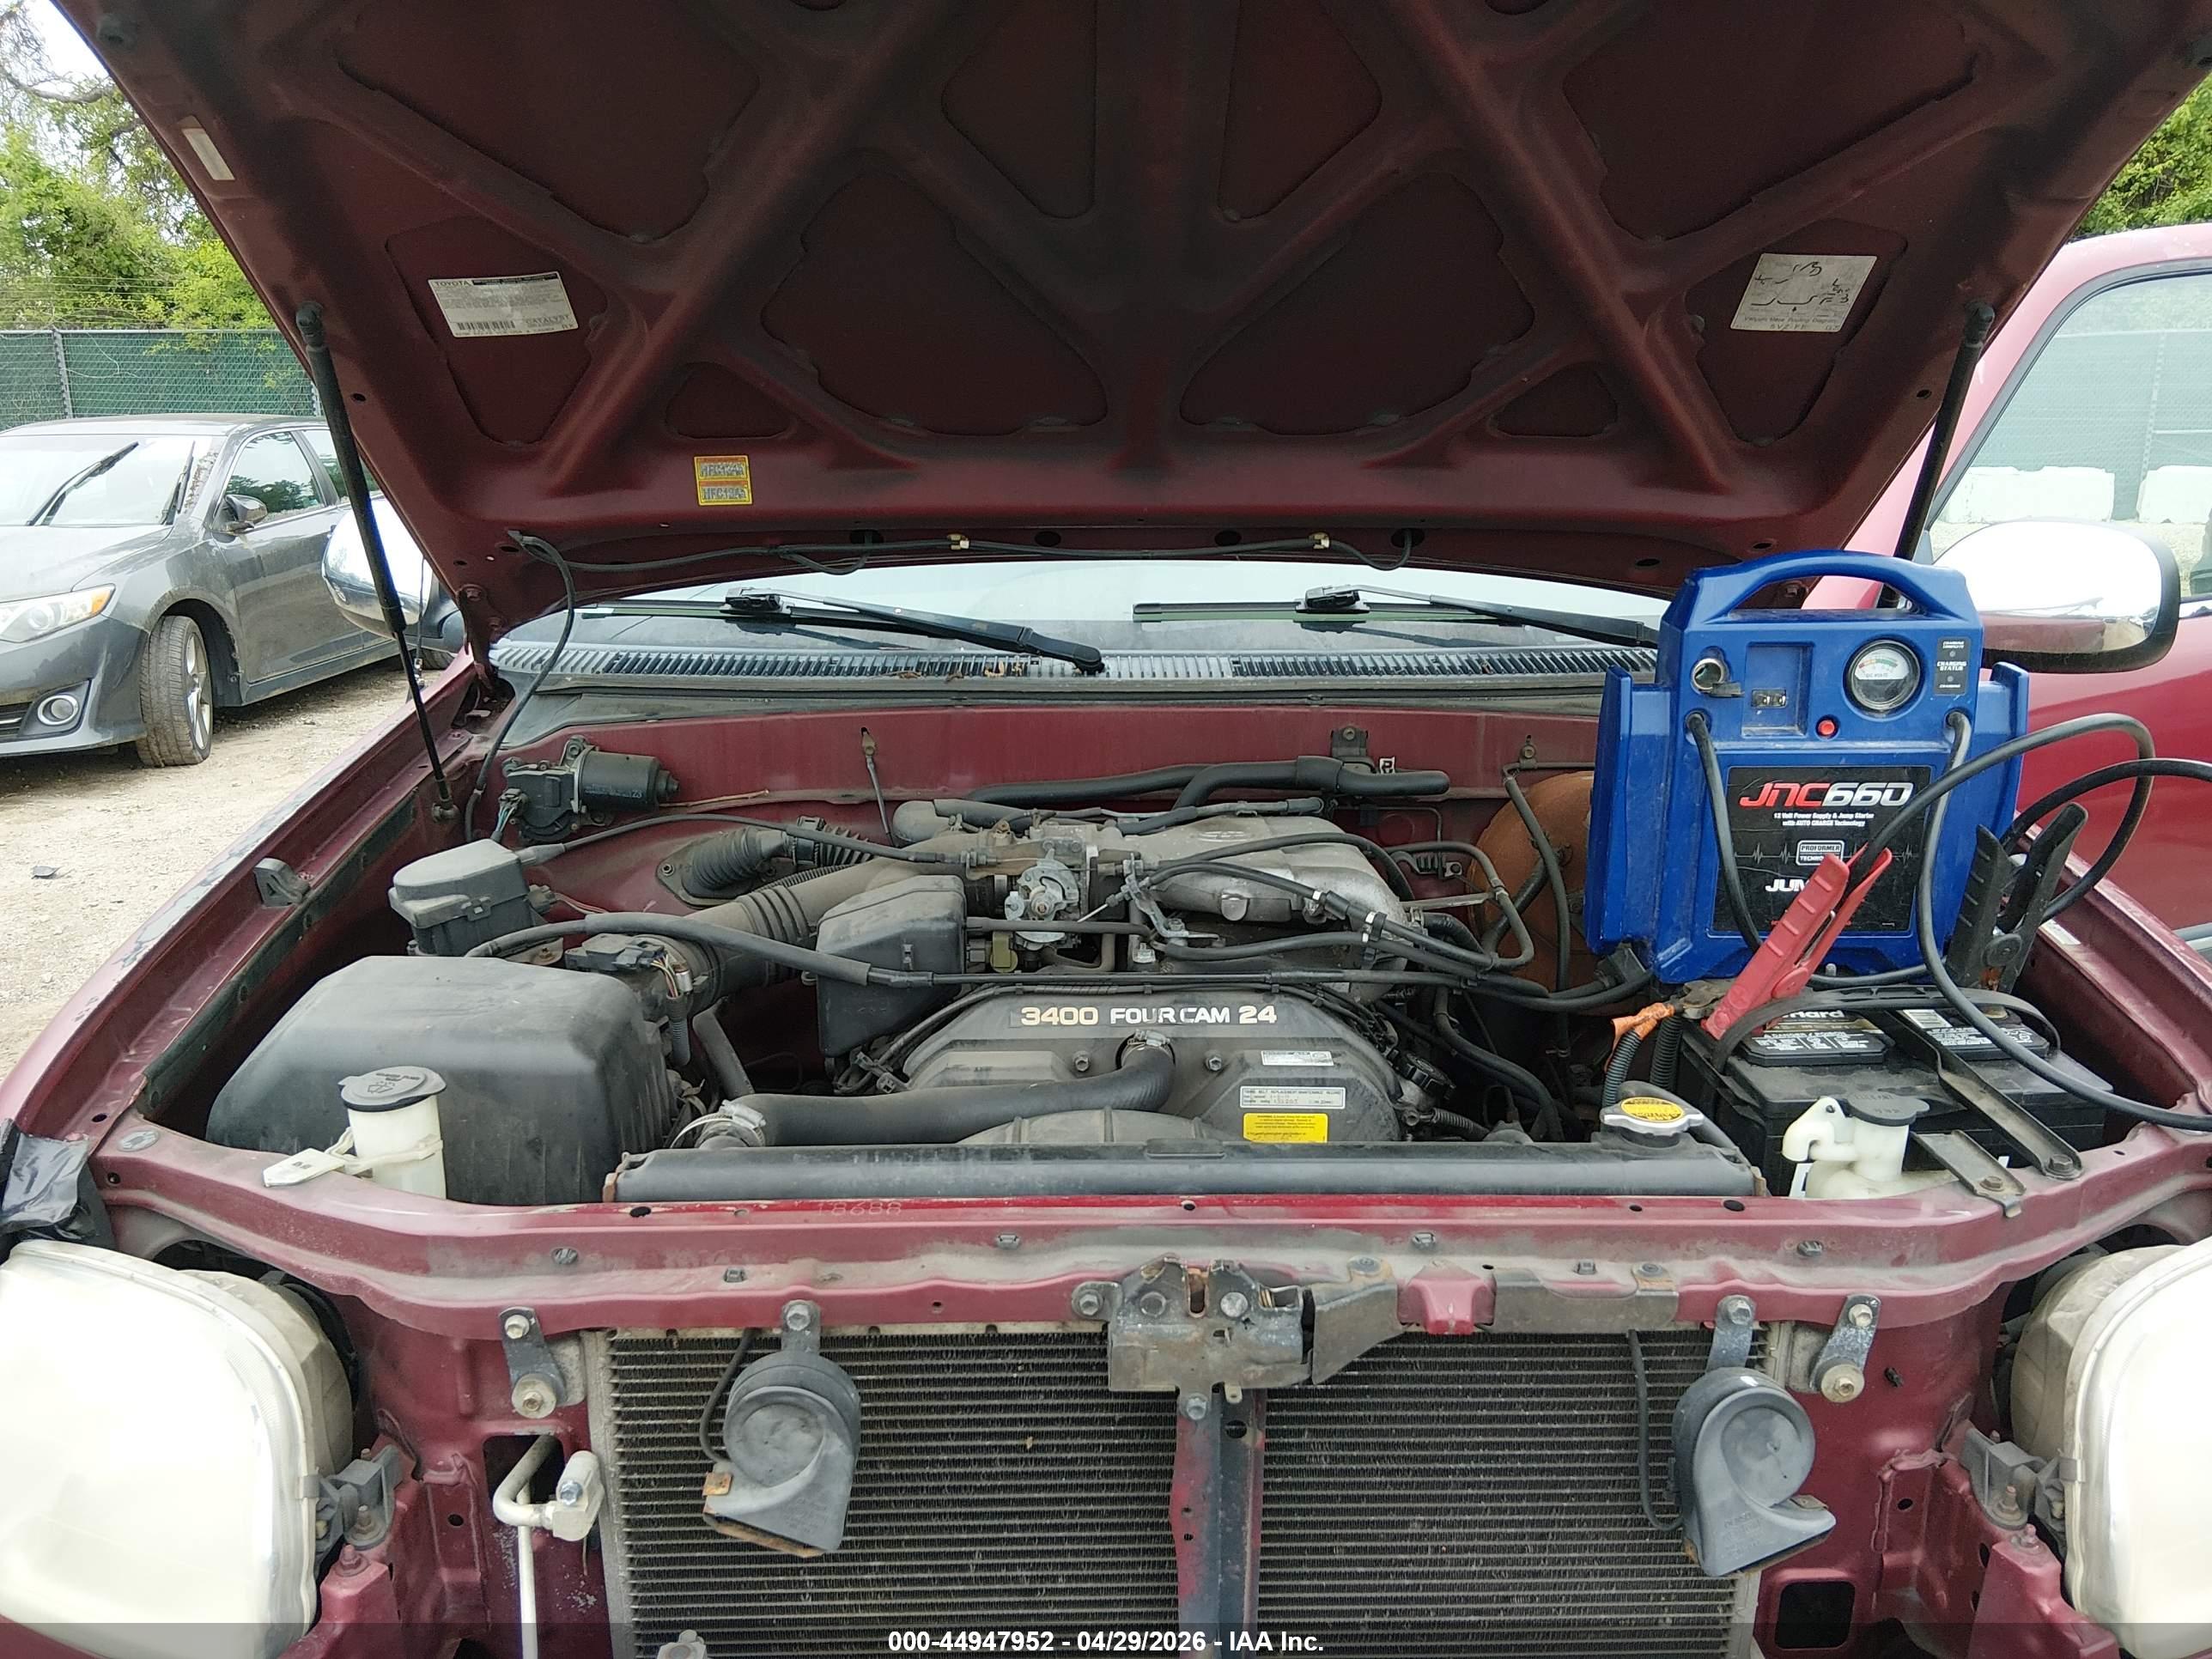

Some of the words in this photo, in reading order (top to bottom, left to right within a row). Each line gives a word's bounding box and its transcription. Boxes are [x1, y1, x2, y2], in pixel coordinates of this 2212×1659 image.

[1739, 782, 1914, 807] JNC660
[1020, 1006, 1098, 1026] 3400
[1109, 1007, 1176, 1024] FOUR
[1180, 1006, 1231, 1024] CAM
[1238, 1005, 1278, 1024] 24
